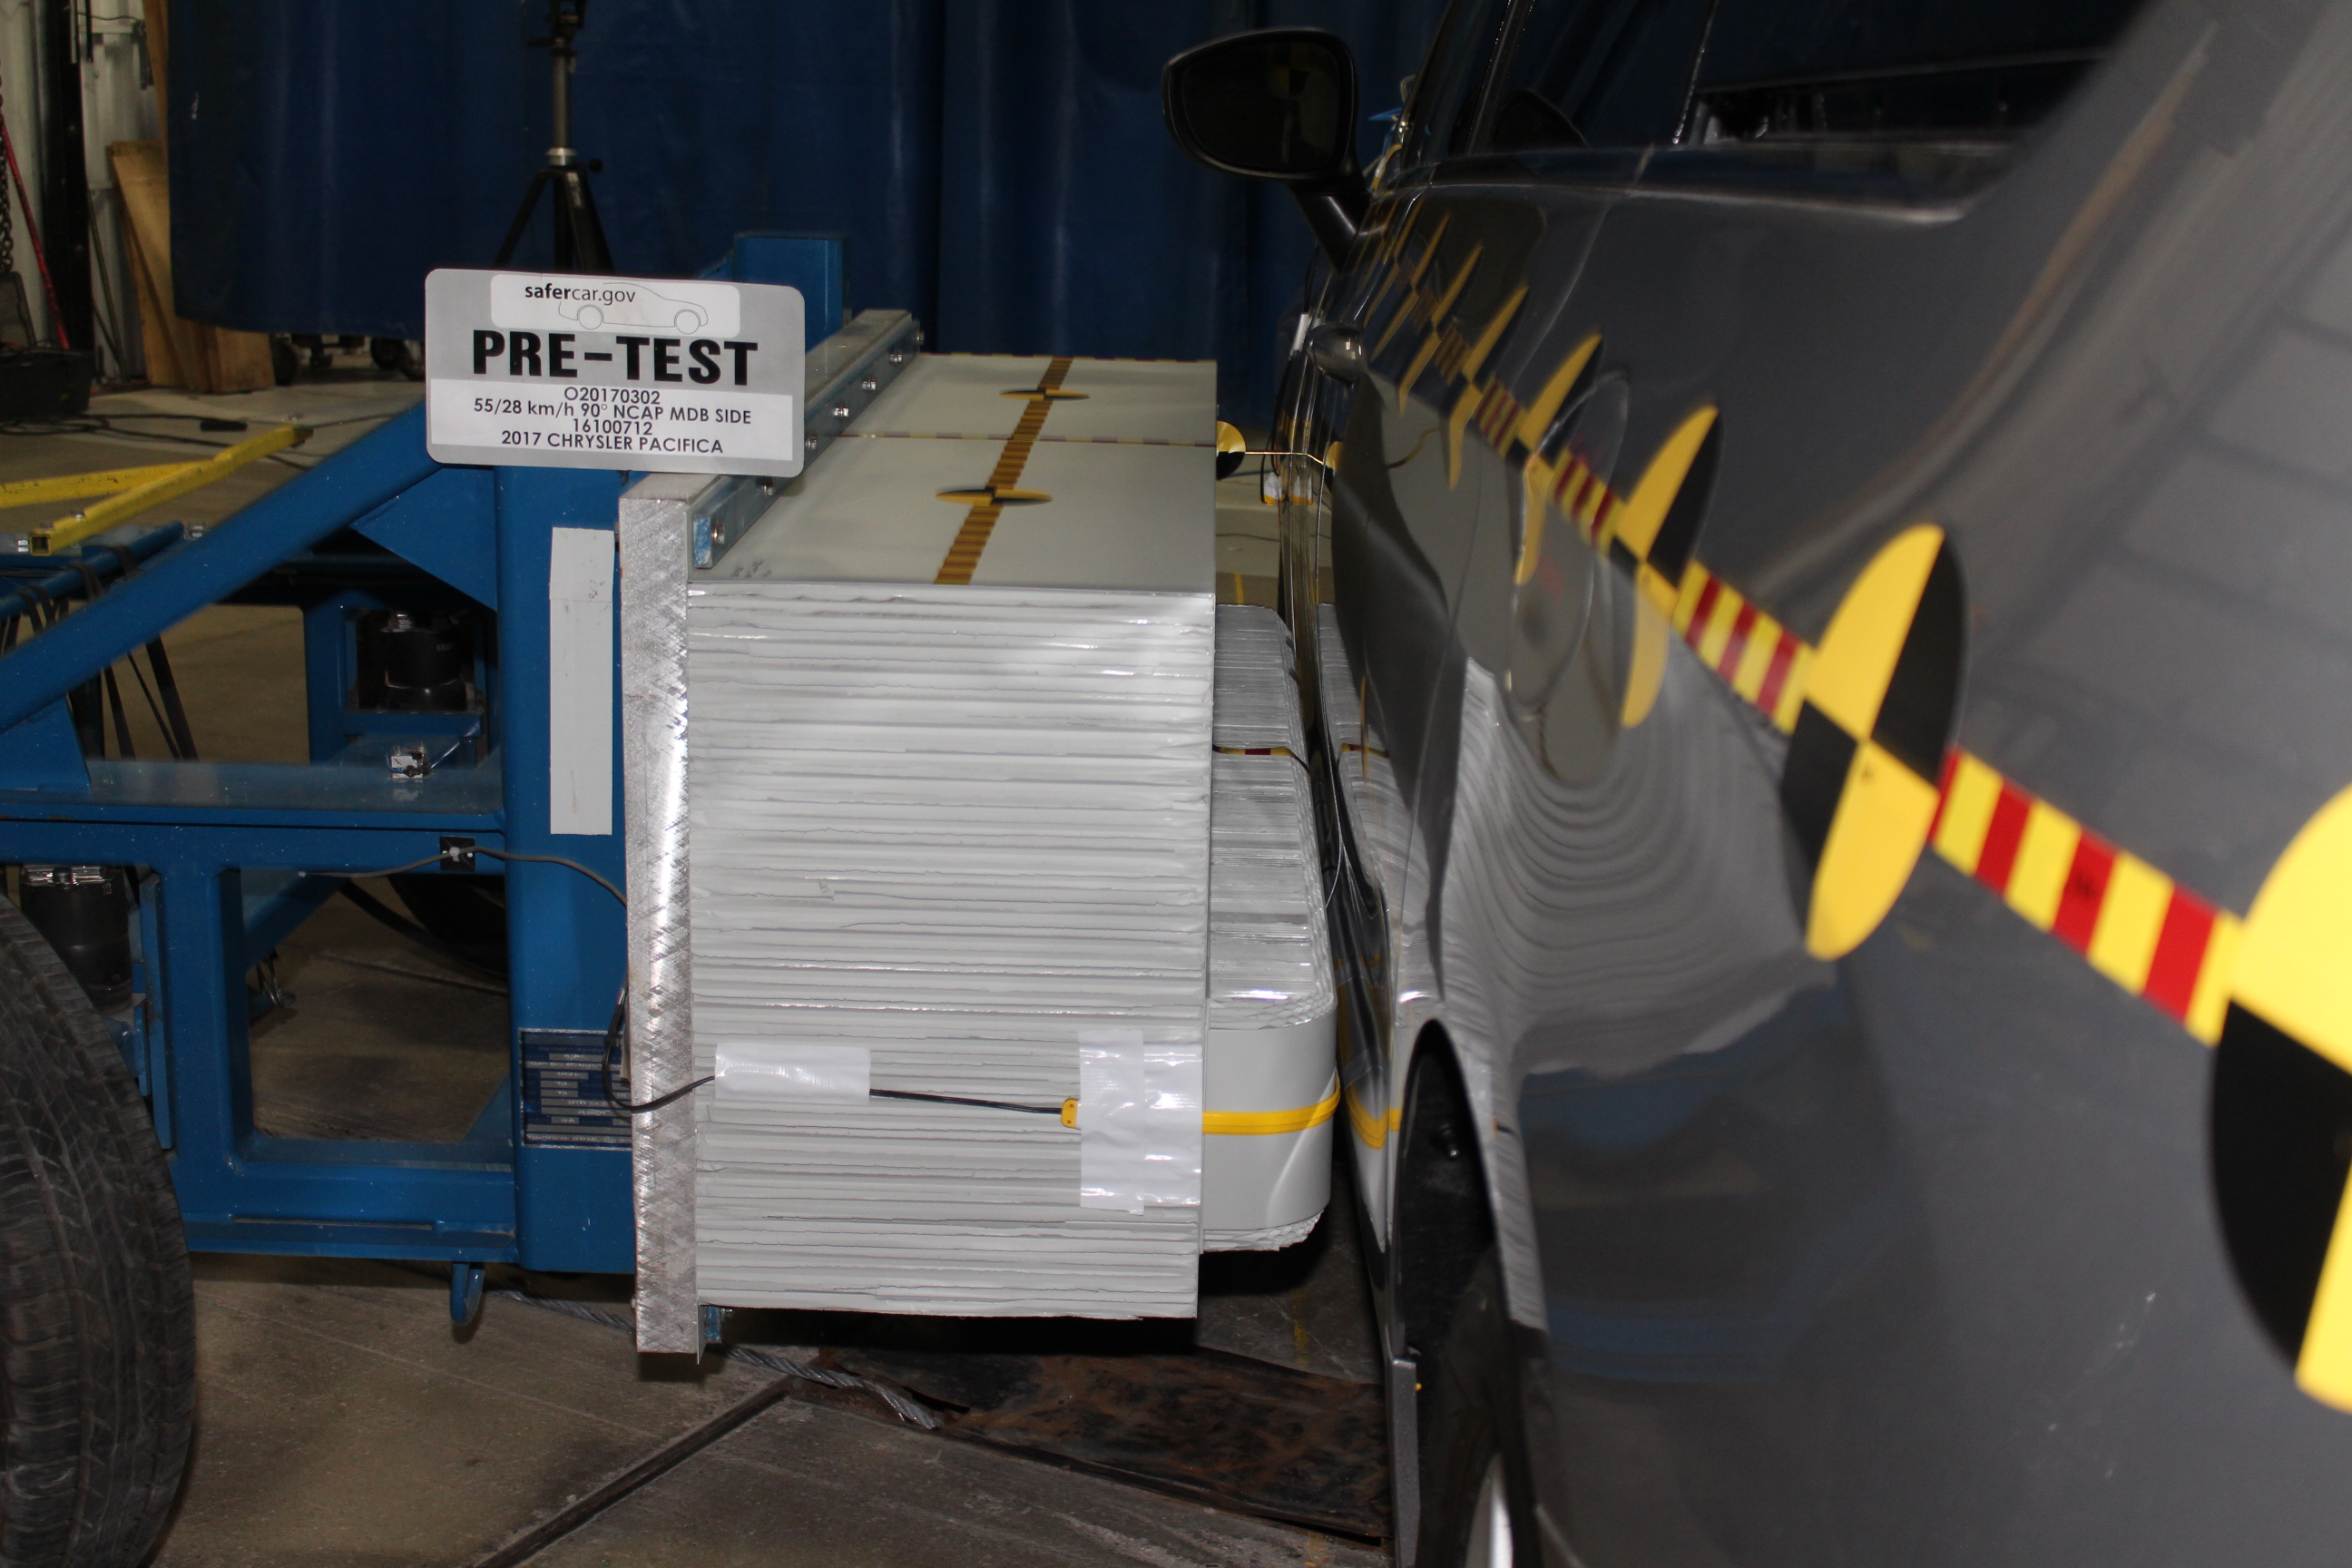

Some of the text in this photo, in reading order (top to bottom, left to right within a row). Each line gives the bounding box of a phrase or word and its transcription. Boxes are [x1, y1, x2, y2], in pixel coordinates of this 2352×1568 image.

[524, 283, 636, 306] safercar.gov
[473, 329, 759, 387] PRE-TEST
[474, 397, 751, 424] 55/28 km/h 90° NCAP MDB SIDE
[573, 418, 652, 436] 16100712
[502, 430, 723, 454] 2017 CHRYSLER PACIFICA
